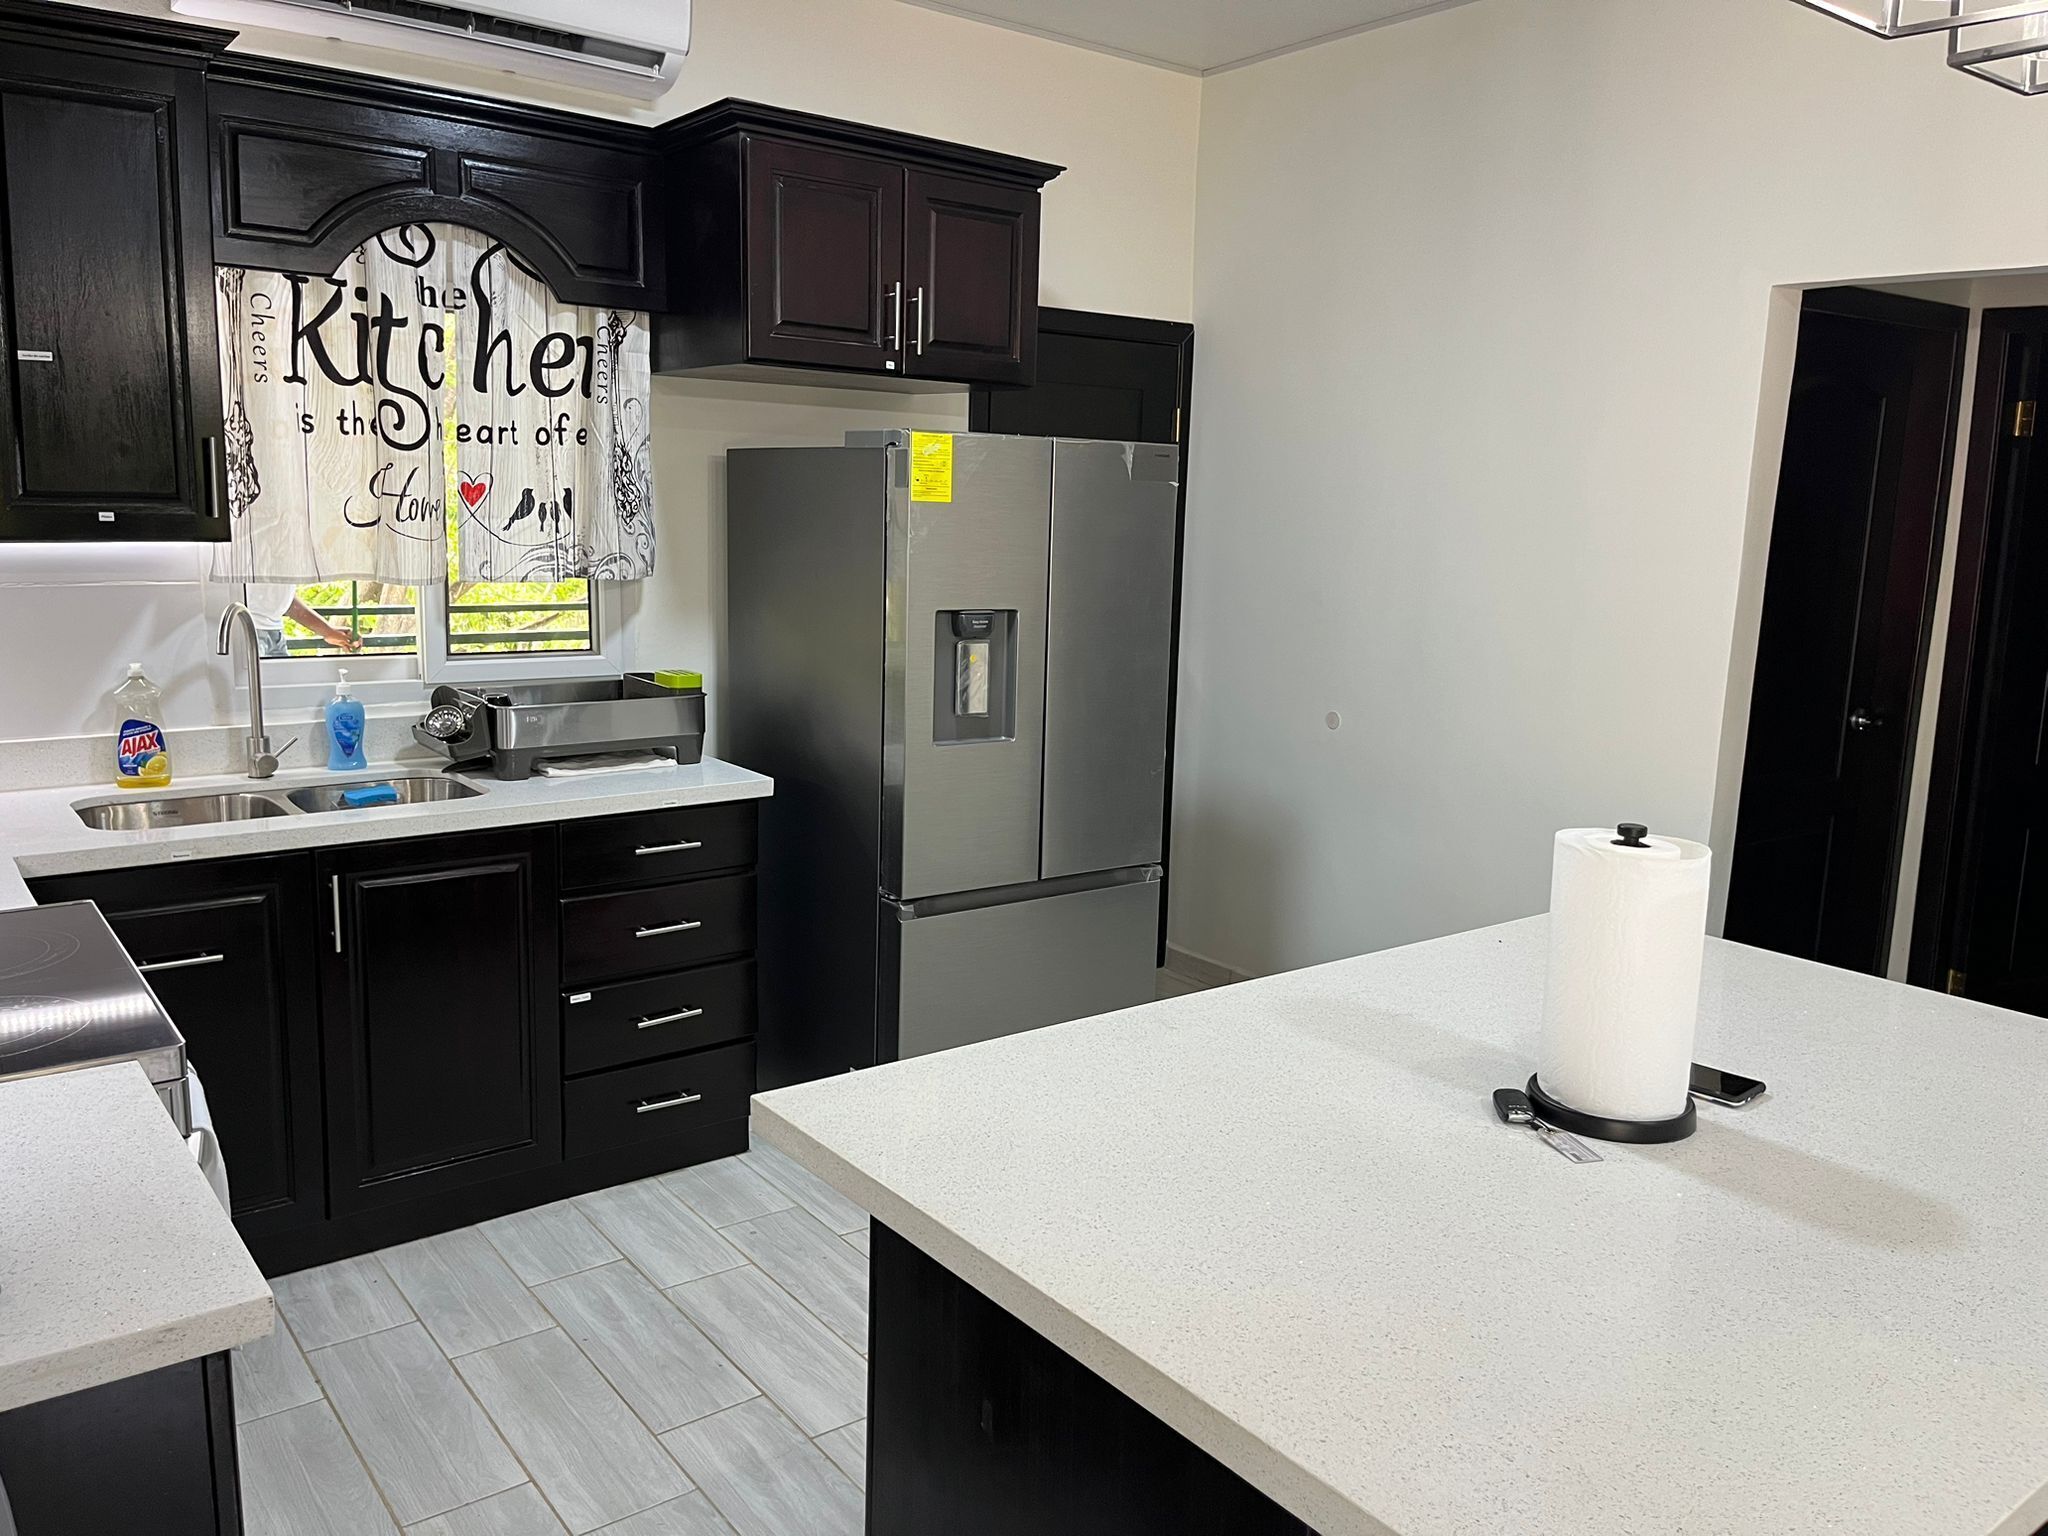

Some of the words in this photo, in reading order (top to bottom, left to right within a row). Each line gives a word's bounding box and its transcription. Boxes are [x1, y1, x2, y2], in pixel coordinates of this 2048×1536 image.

[250, 292, 276, 384] Cheers
[596, 325, 611, 405] Cheers
[295, 402, 315, 434] is
[121, 731, 159, 758] AJAX
